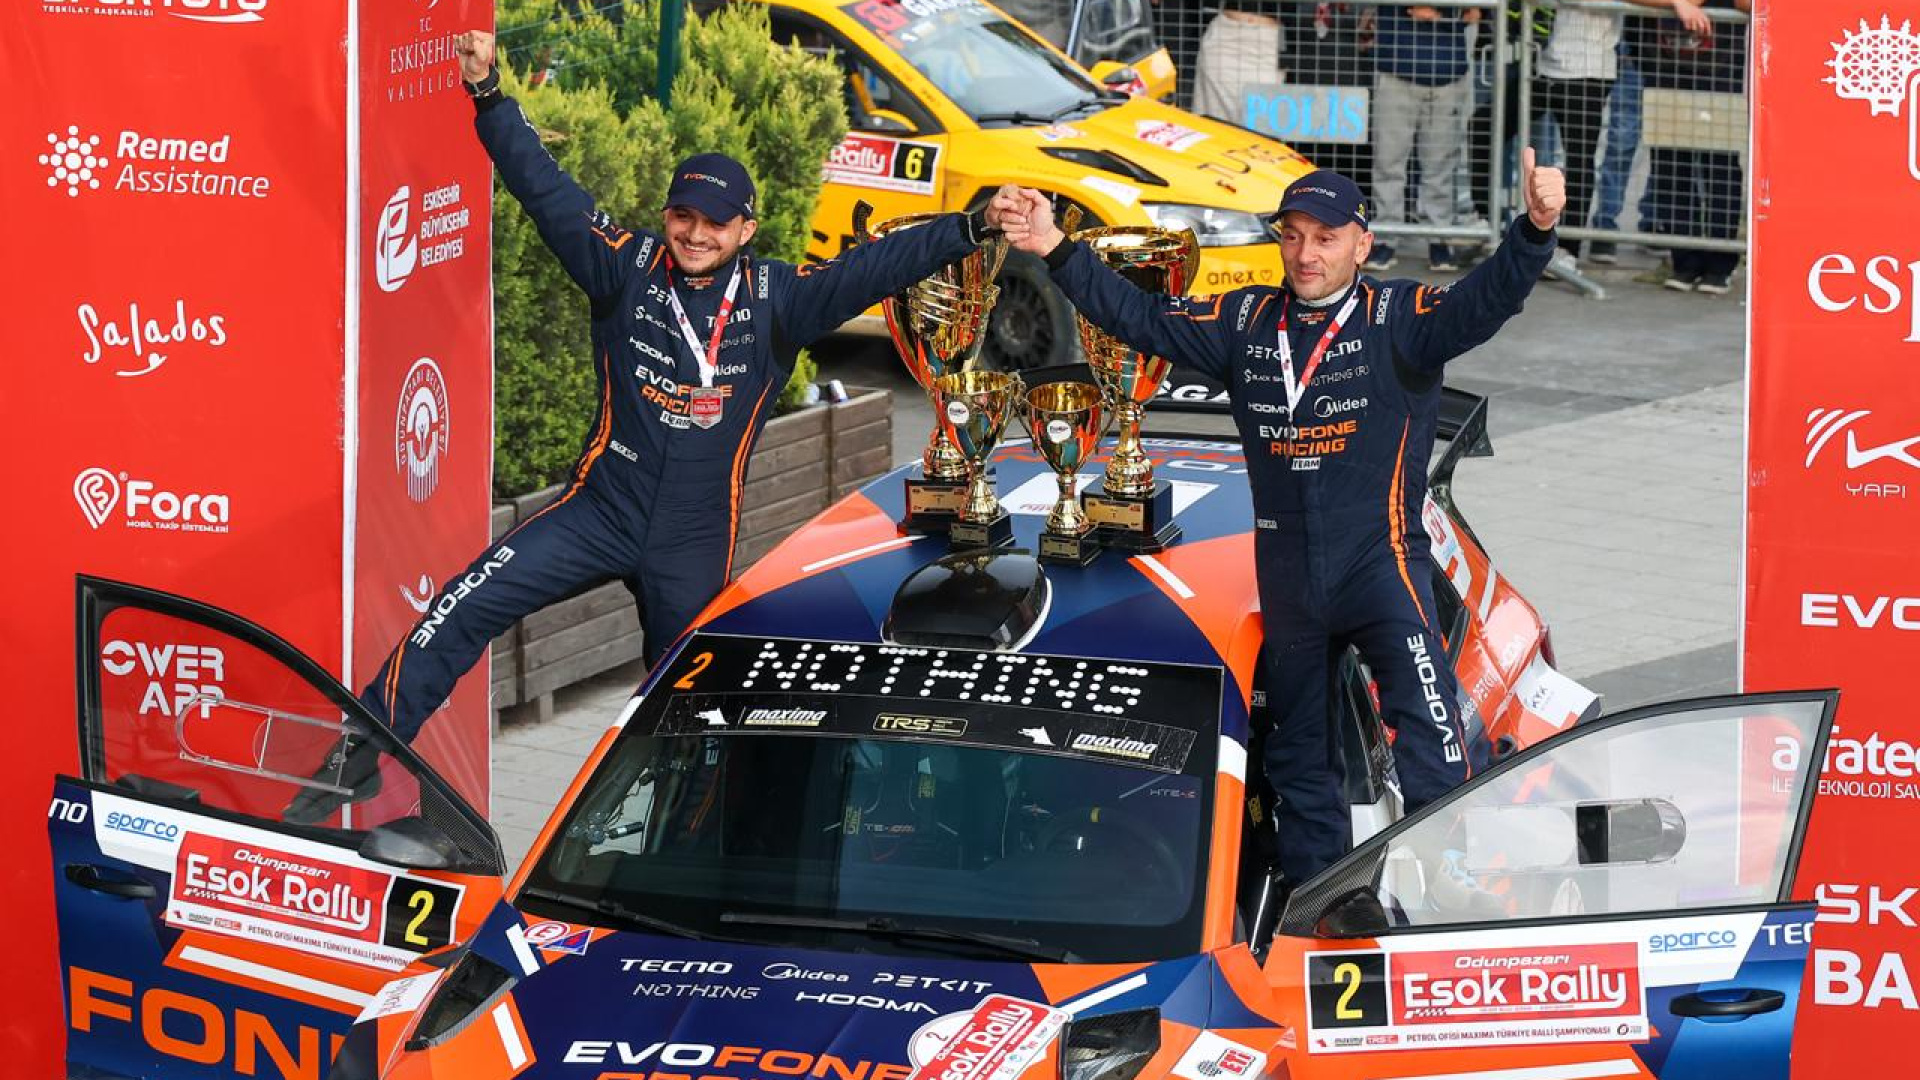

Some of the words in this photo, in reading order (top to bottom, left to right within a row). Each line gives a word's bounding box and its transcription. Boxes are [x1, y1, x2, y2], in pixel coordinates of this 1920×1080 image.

[1245, 89, 1366, 140] POLİS
[116, 131, 229, 163] Remed
[830, 145, 886, 174] Rally
[905, 148, 925, 180] 6
[115, 163, 270, 198] Assistance
[1206, 268, 1256, 285] anex
[77, 299, 228, 364] Salados
[1291, 457, 1321, 471] TEAM
[126, 480, 229, 523] Fora
[1845, 482, 1906, 499] YAPI
[410, 545, 516, 649] EVOFONE
[674, 652, 714, 689] 2
[743, 642, 1149, 714] NOTHING
[745, 707, 828, 721] maxima
[1406, 633, 1462, 764] EVOFONE
[1073, 733, 1158, 754] maxima
[104, 810, 179, 838] sparco
[233, 848, 331, 879] Odunpazarı
[186, 854, 272, 902] Esok
[282, 875, 372, 925] Rally
[403, 890, 434, 946] 2
[1649, 930, 1736, 951] sparco
[620, 958, 734, 975] TECNO
[778, 967, 850, 983] Midea
[1454, 954, 1571, 970] Odunpazarı
[631, 983, 761, 1000] NOTHING
[872, 972, 993, 995] PETKIT
[1333, 963, 1363, 1020] 2
[1403, 968, 1508, 1008] Esok
[1520, 964, 1628, 1010] Rally
[1814, 949, 1919, 1010] BA
[925, 1030, 949, 1042] 2
[966, 1003, 1034, 1047] Rally
[1406, 1033, 1438, 1043] PETROL
